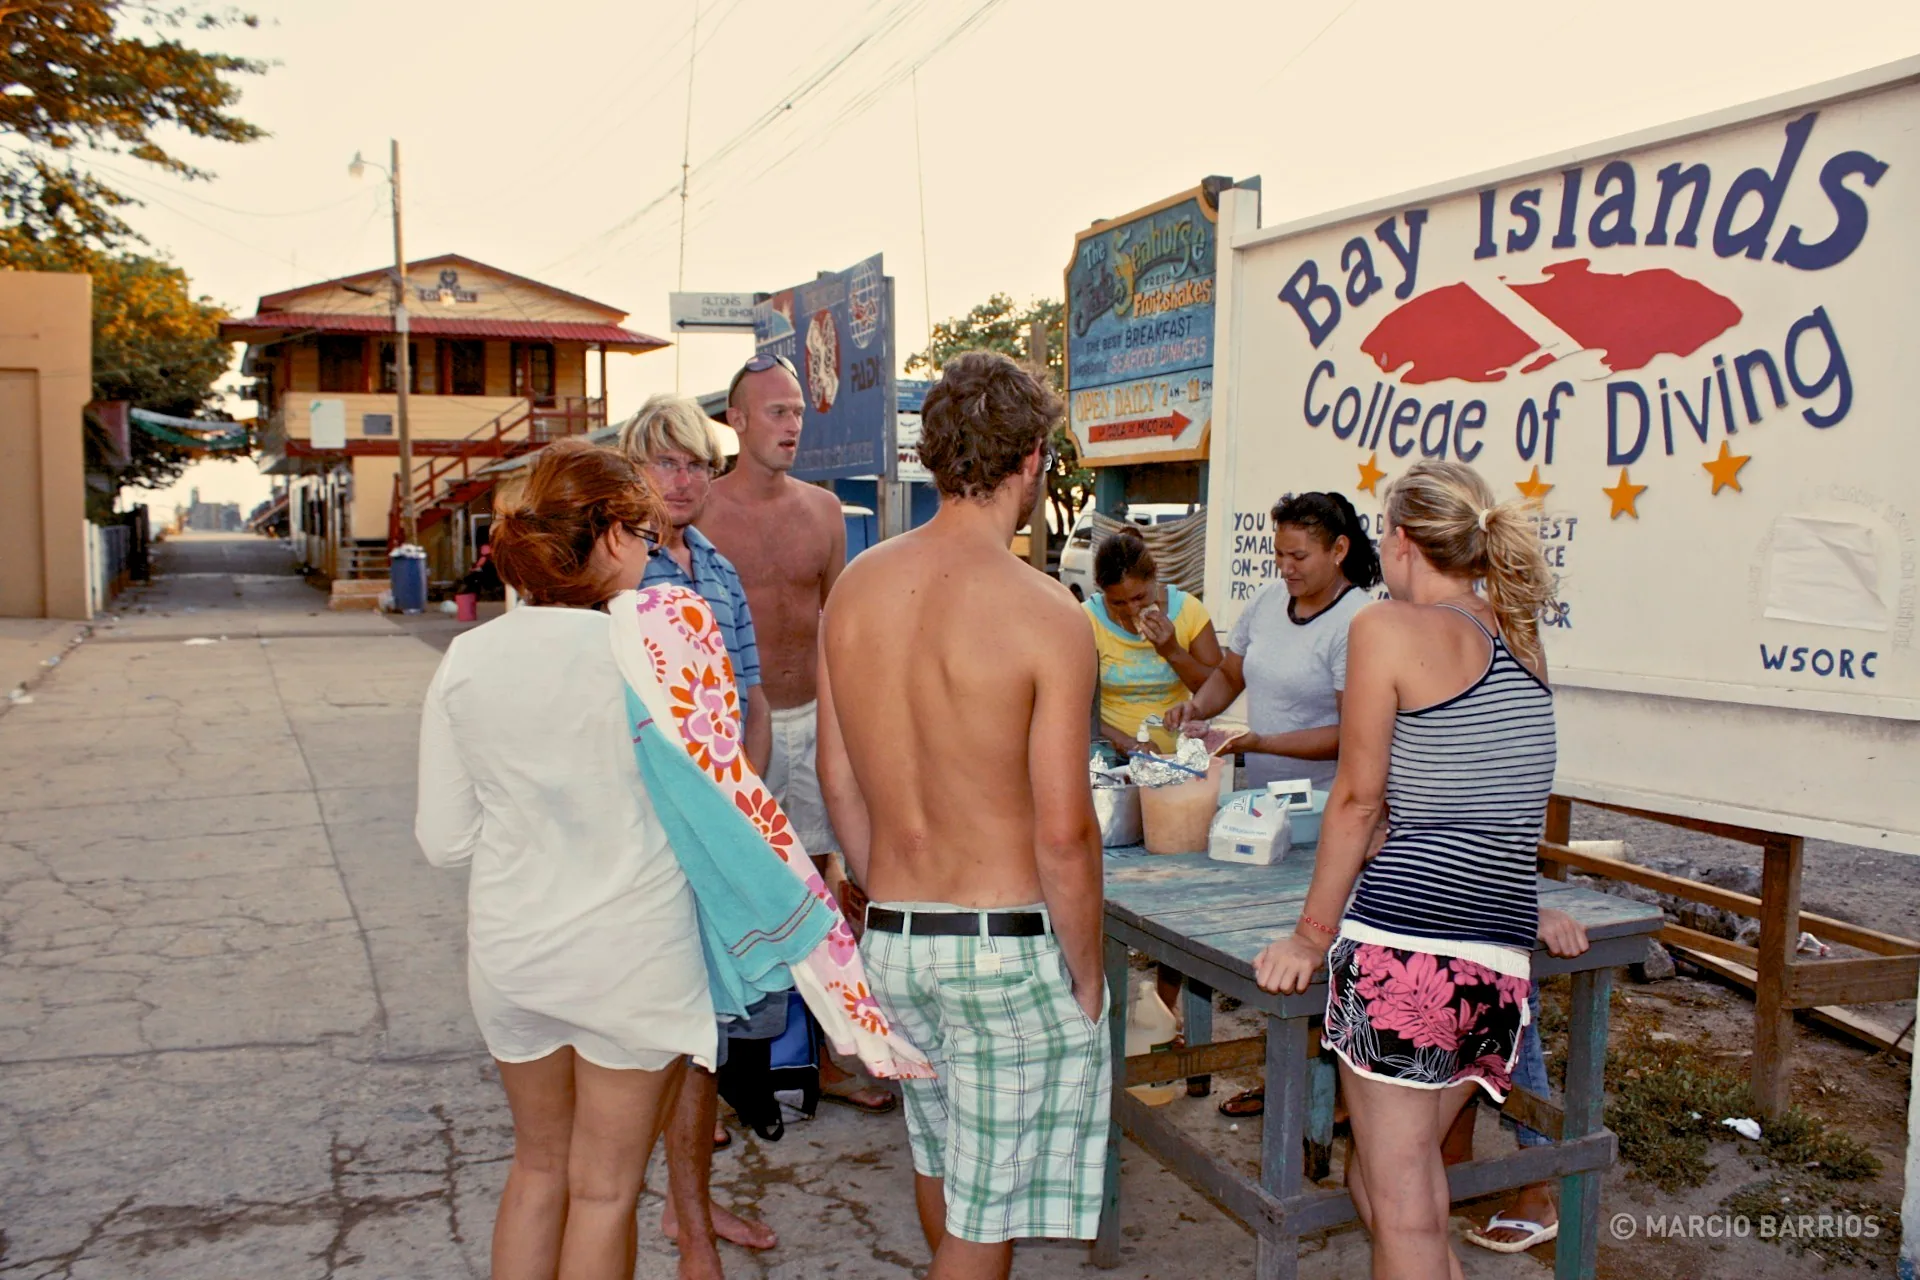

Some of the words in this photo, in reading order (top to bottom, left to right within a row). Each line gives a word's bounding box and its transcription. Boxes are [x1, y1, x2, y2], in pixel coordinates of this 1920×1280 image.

[1277, 208, 1429, 349] Bay
[1473, 111, 1891, 271] Islands
[1083, 240, 1106, 271] The
[701, 308, 726, 317] DIVE
[1125, 316, 1192, 348] BREAKFAST
[1302, 359, 1488, 463] College
[1516, 381, 1575, 466] of
[1606, 305, 1854, 466] Diving
[1074, 389, 1110, 422] OPEN
[1114, 381, 1157, 416] DAILY
[1234, 512, 1266, 531] YOU
[1234, 535, 1275, 554] SMAL
[1232, 559, 1283, 579] ON-SIT
[1759, 643, 1878, 680] WSORC
